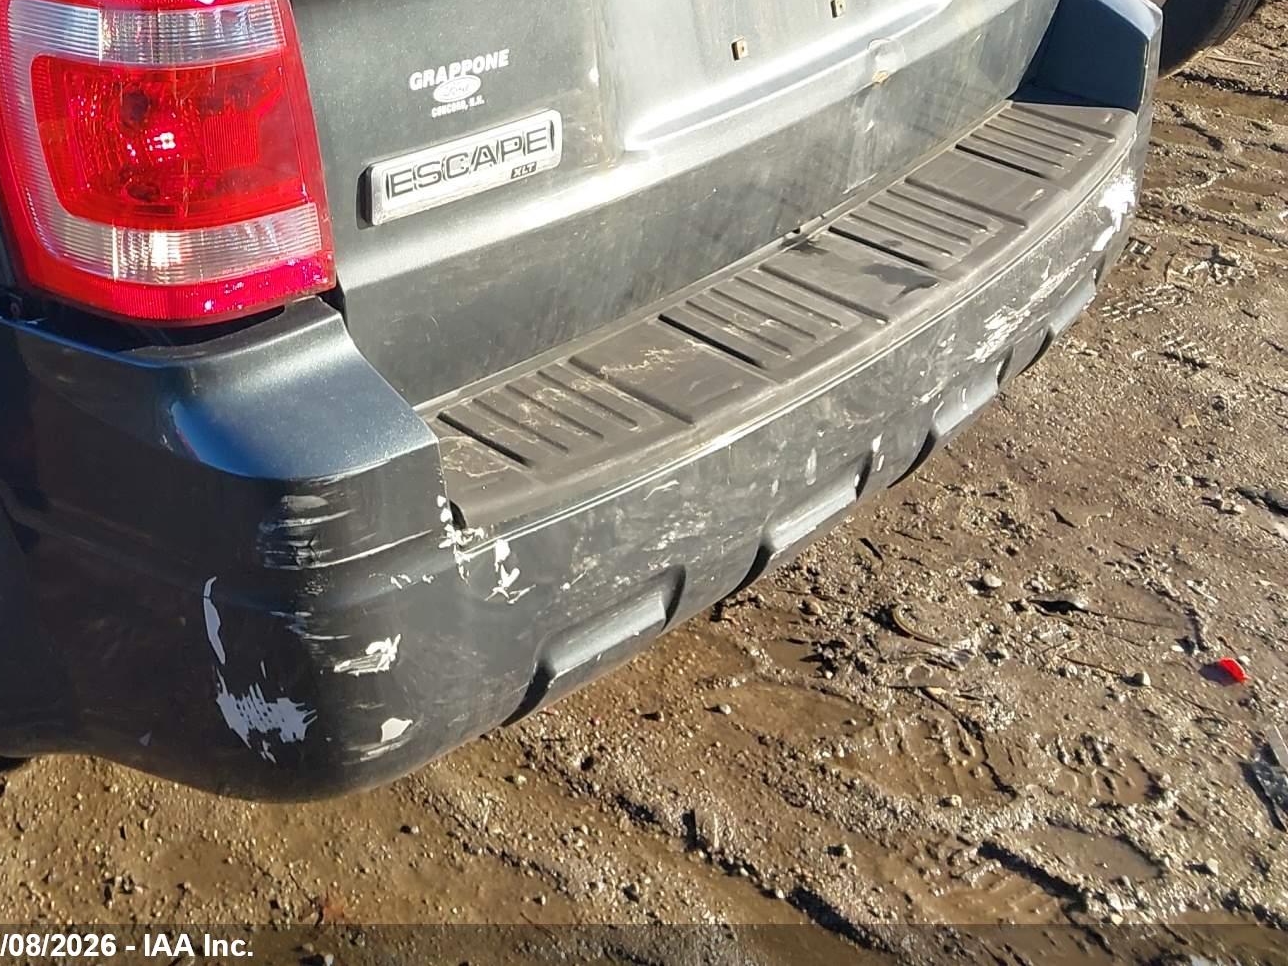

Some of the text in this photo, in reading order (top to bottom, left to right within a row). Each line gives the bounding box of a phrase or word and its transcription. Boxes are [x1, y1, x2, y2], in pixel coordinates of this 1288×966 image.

[409, 48, 510, 91] GRAPPONE
[388, 126, 549, 198] ESCAPE
[511, 161, 537, 180] XLT
